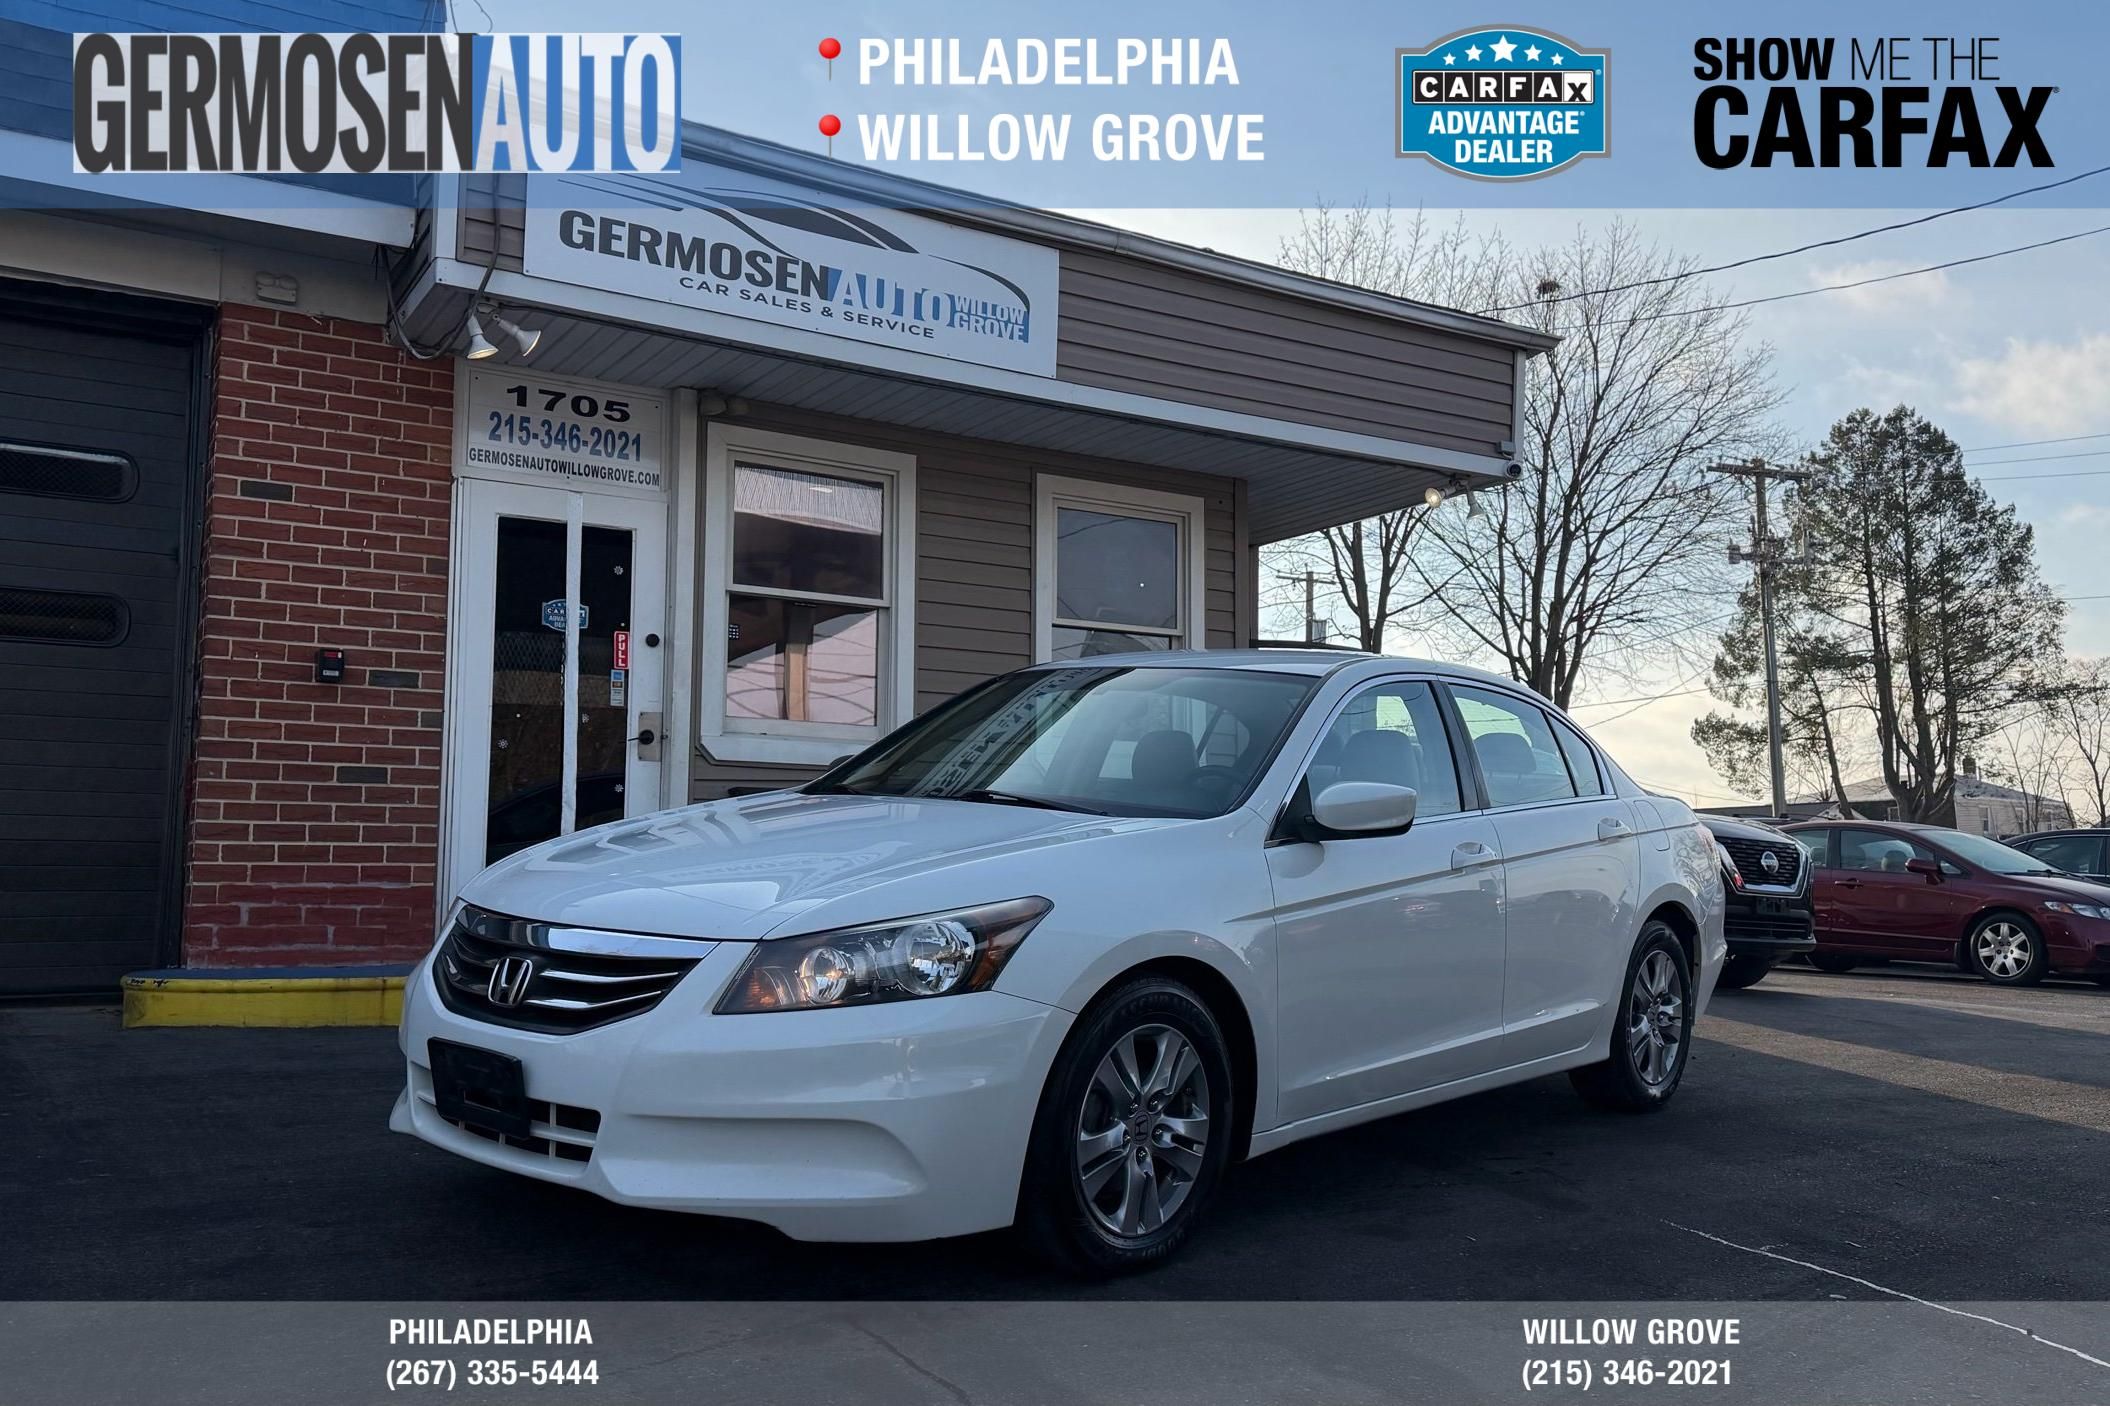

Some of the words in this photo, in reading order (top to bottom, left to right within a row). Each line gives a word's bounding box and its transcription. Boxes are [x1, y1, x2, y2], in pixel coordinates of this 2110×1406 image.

[679, 277, 729, 297] CAR
[739, 289, 812, 313] SALES
[820, 306, 834, 318] &
[843, 311, 935, 339] SERVICE
[953, 311, 1025, 343] GROVE
[955, 295, 1025, 325] WILLOW
[506, 385, 631, 423] 1705
[488, 411, 641, 462] 215-346-2021
[469, 447, 660, 486] GERMOSENAUTOWILLOWGROVE.COM
[618, 634, 626, 667] PULL
